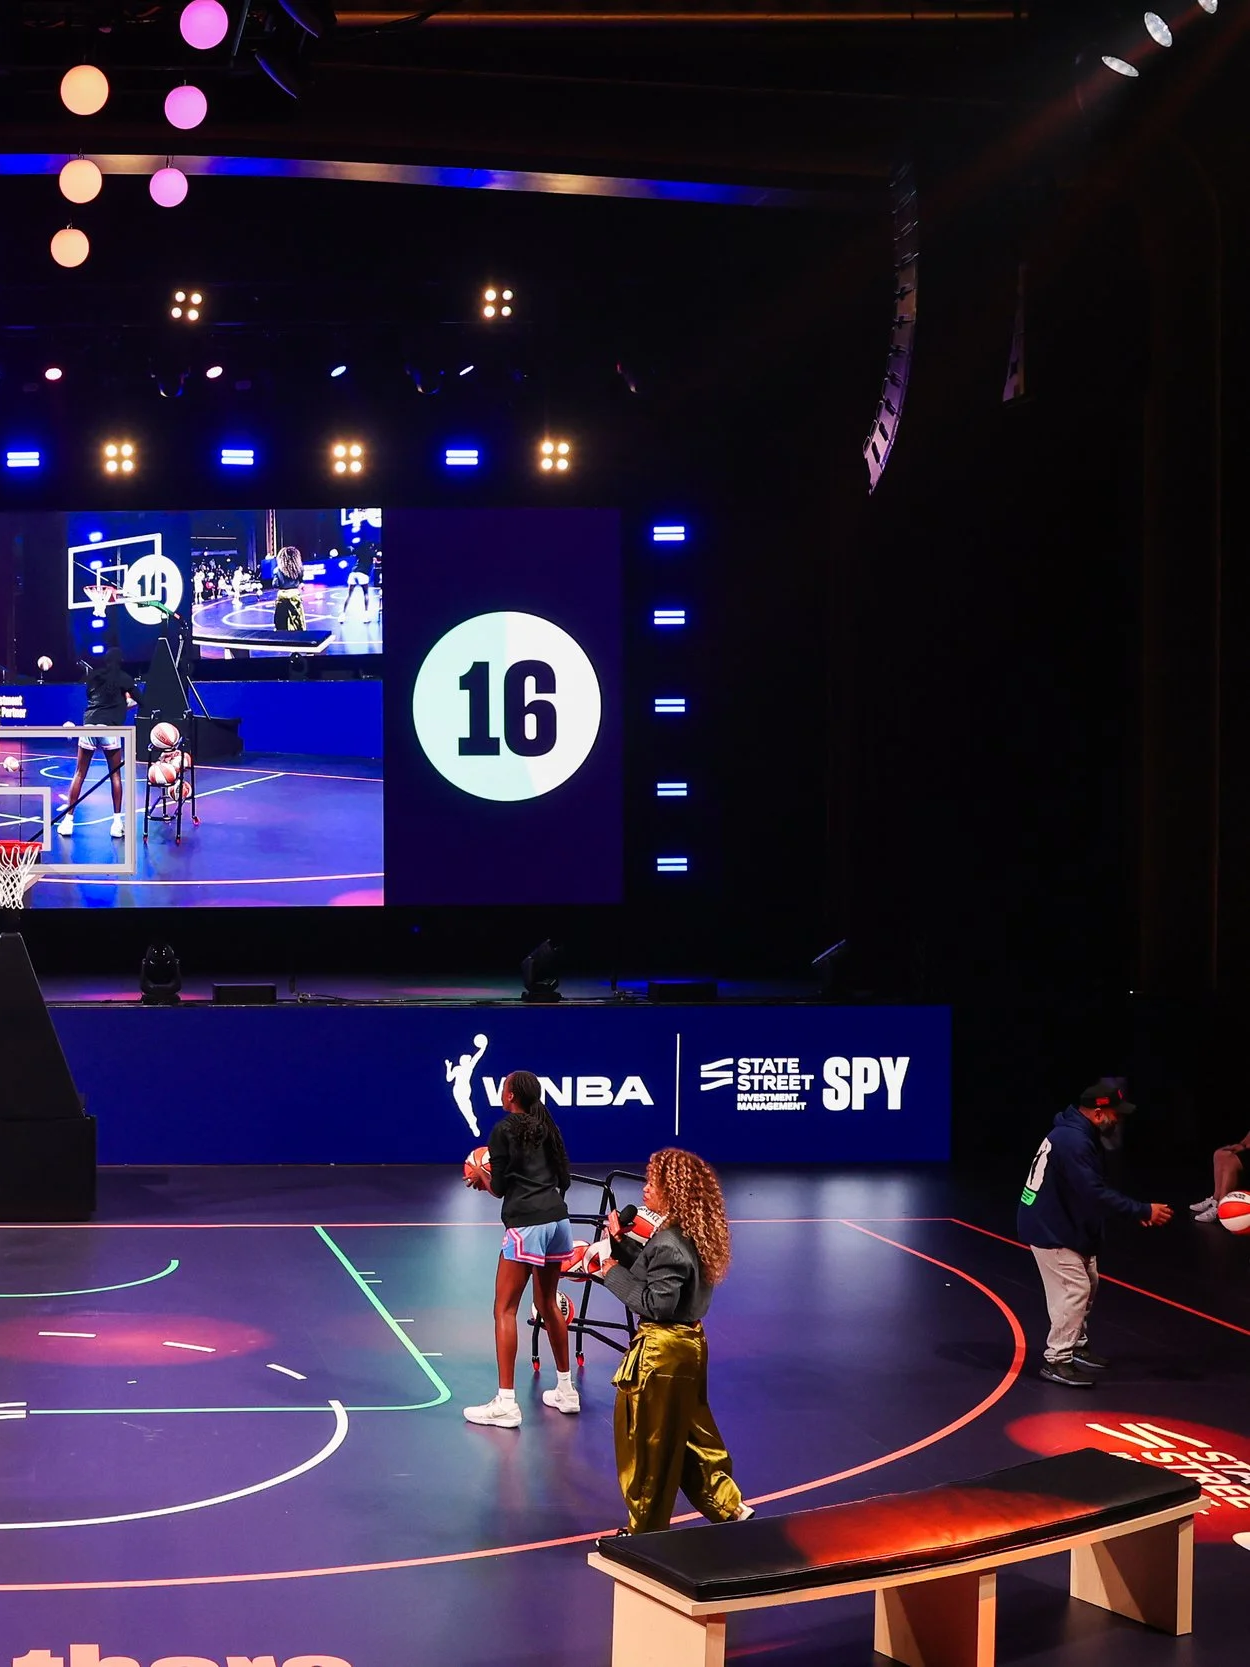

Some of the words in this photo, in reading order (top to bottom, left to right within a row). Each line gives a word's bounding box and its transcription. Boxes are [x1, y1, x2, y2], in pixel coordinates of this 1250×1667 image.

[459, 660, 557, 757] 16
[737, 1058, 799, 1074] STATE
[737, 1074, 814, 1091] STREET
[822, 1056, 910, 1111] SPY
[737, 1093, 799, 1102] INVESTMENT
[736, 1102, 807, 1111] MANAGEMENT
